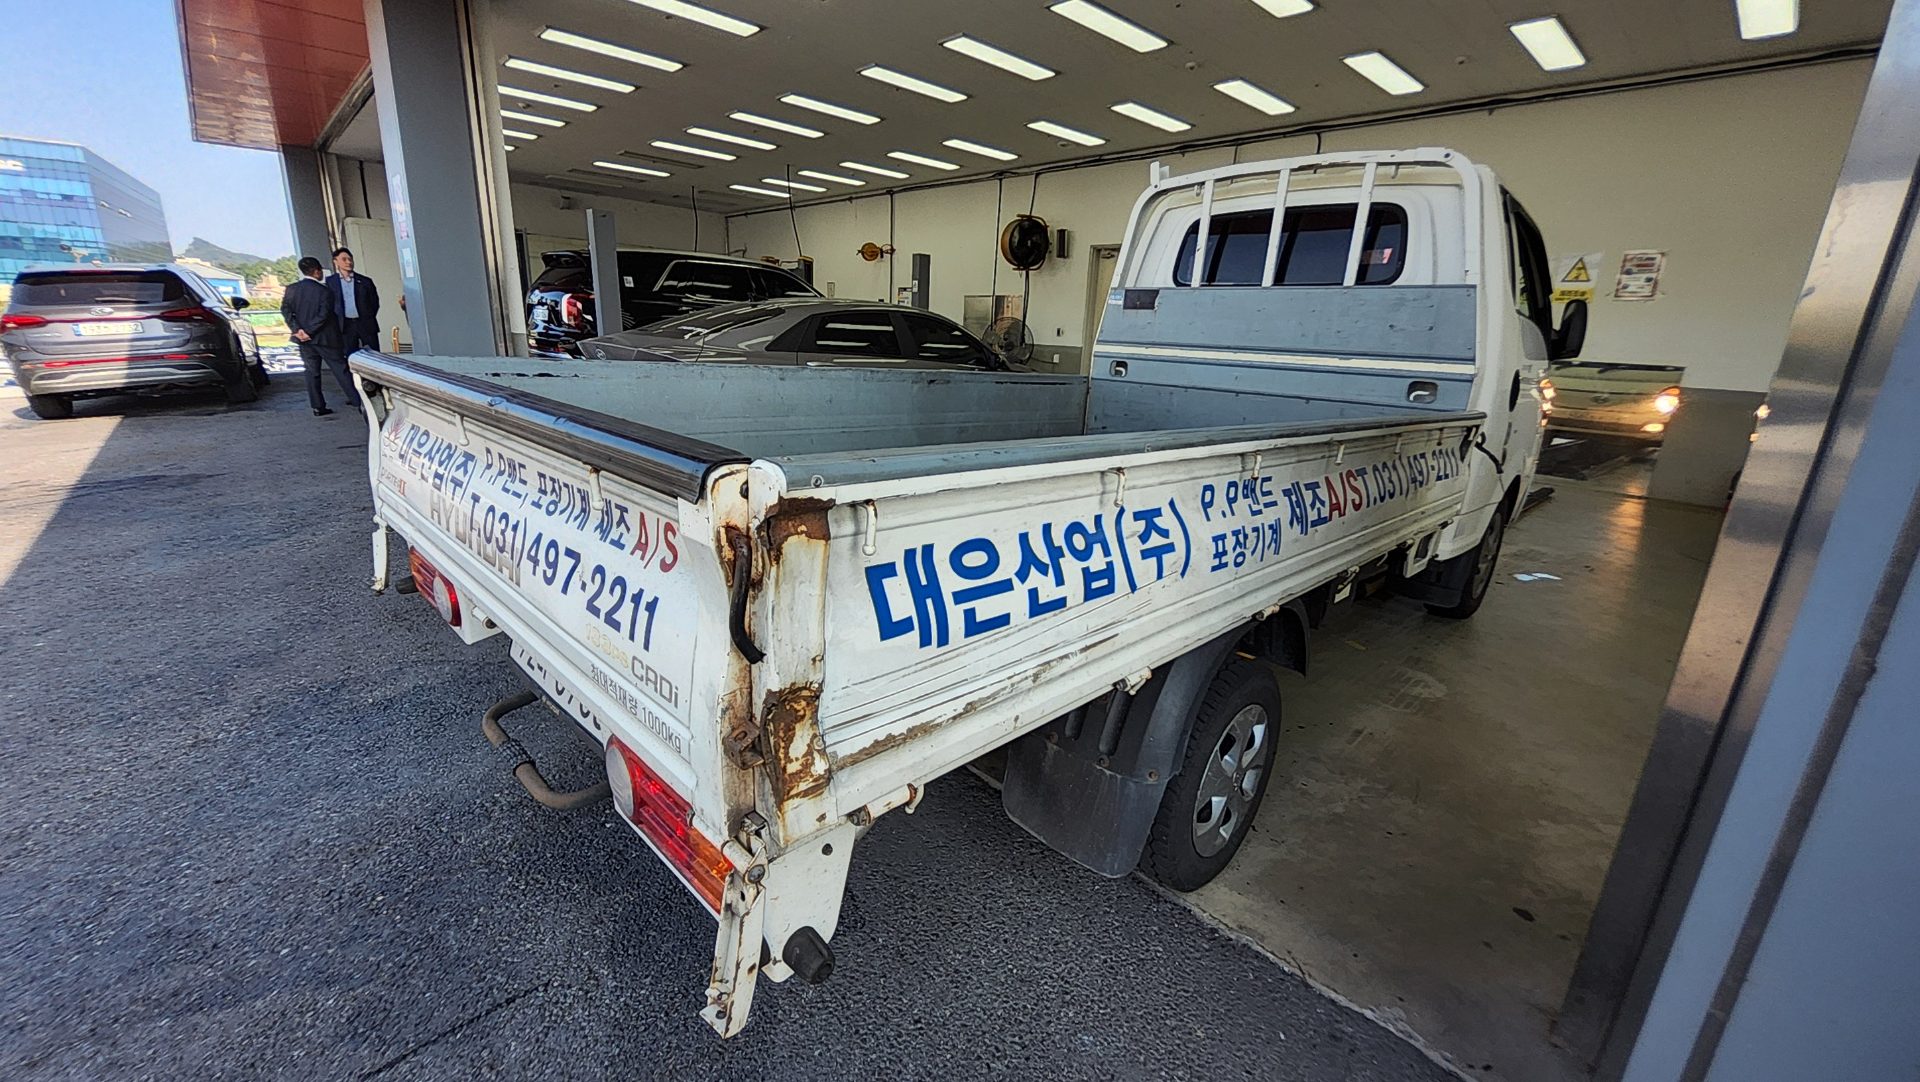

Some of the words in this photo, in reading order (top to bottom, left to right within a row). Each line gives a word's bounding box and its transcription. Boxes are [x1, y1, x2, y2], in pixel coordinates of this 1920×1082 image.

[399, 423, 478, 505] 대은산업(주)
[530, 470, 591, 531] 포장기계
[593, 497, 631, 551] 제조
[629, 511, 679, 573] A/S
[1281, 480, 1330, 536] 제조
[863, 496, 1192, 649] 대은산업(주)
[1209, 517, 1283, 573] 포장기계
[641, 706, 682, 754] 1000kg
